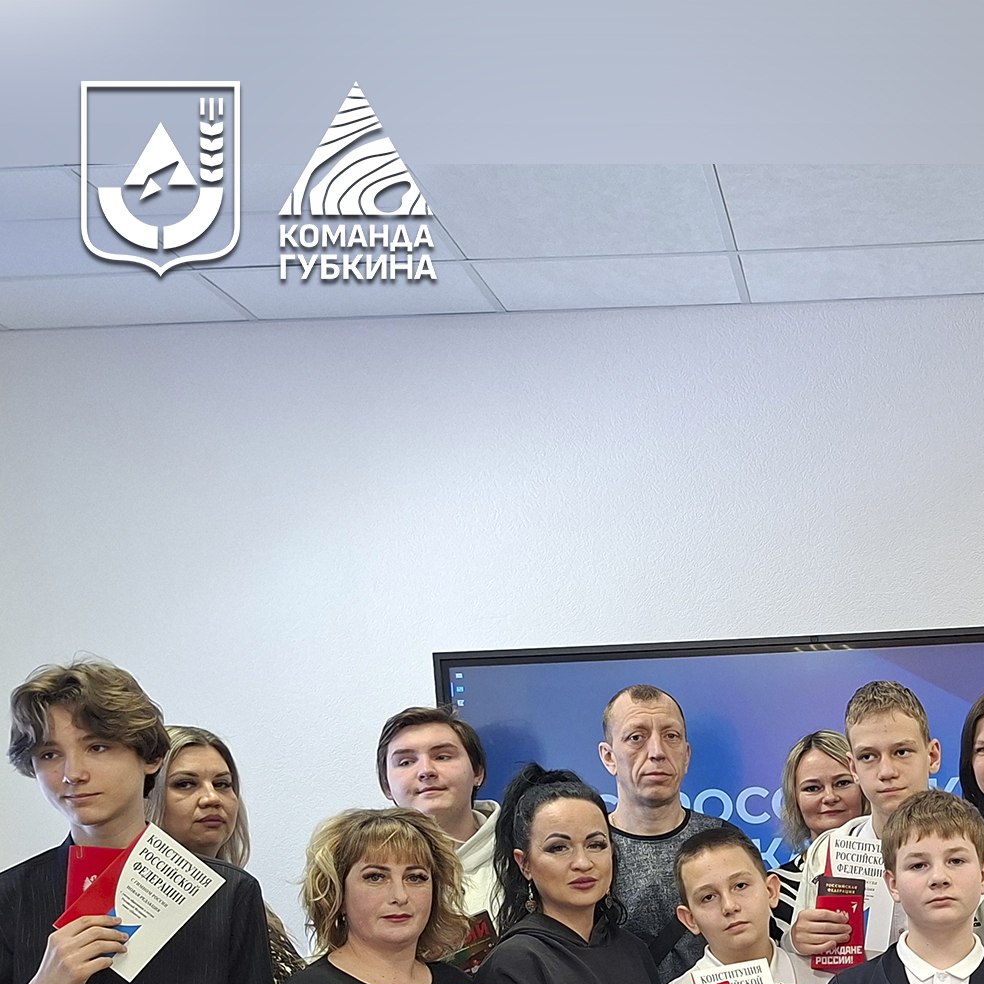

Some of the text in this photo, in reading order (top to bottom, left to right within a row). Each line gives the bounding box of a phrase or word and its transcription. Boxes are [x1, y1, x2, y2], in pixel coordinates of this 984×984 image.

[835, 839, 881, 853] КОНСТИТУ
[147, 834, 212, 888] КОНСТИТУЦИЯ
[836, 851, 884, 865] РОССИЙСКО
[139, 847, 200, 897] РОССИЙСКОЙ
[132, 862, 186, 905] ФЕДЕРАЦИИ
[815, 956, 854, 965] РОССИИ!
[700, 965, 762, 984] КОНСТИТУЦИЯ
